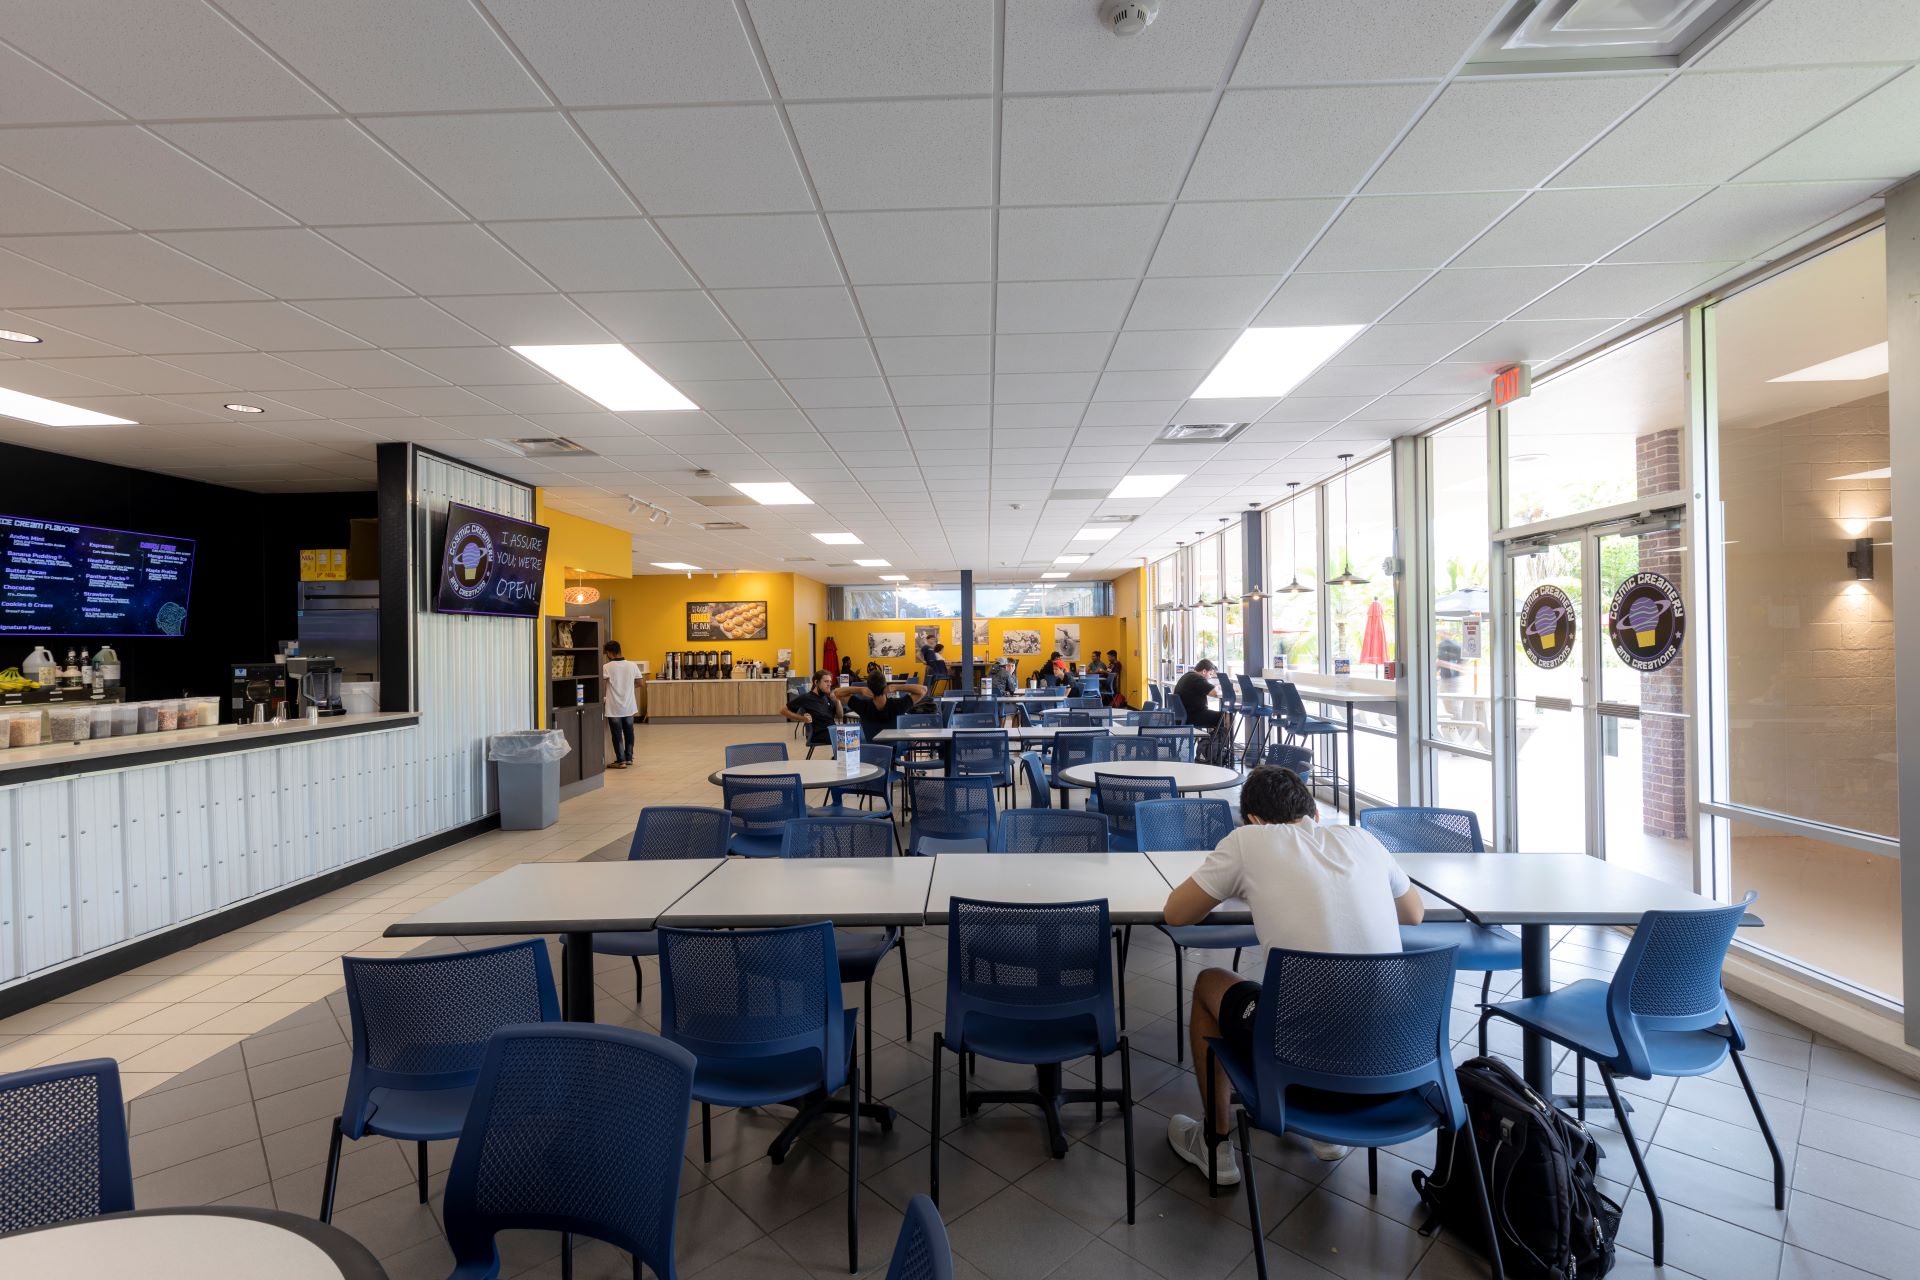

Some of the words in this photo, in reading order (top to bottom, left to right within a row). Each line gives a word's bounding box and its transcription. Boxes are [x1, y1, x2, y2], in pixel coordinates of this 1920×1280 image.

[45, 523, 79, 533] FLAVORS
[449, 526, 471, 556] COSMIC
[501, 531, 509, 545] I
[510, 534, 542, 552] ASSURE
[518, 556, 542, 571] WE'RE
[496, 578, 537, 601] OPEN!
[1610, 577, 1637, 620] COSMIC
[1637, 573, 1684, 618] CREAMERY
[1521, 590, 1540, 627] COSMIC
[1540, 585, 1575, 622] CREAMERY
[1526, 648, 1538, 663] AND
[1538, 644, 1571, 668] CREATIONS
[1616, 645, 1631, 662] AND
[1632, 645, 1677, 670] CREATIONS
